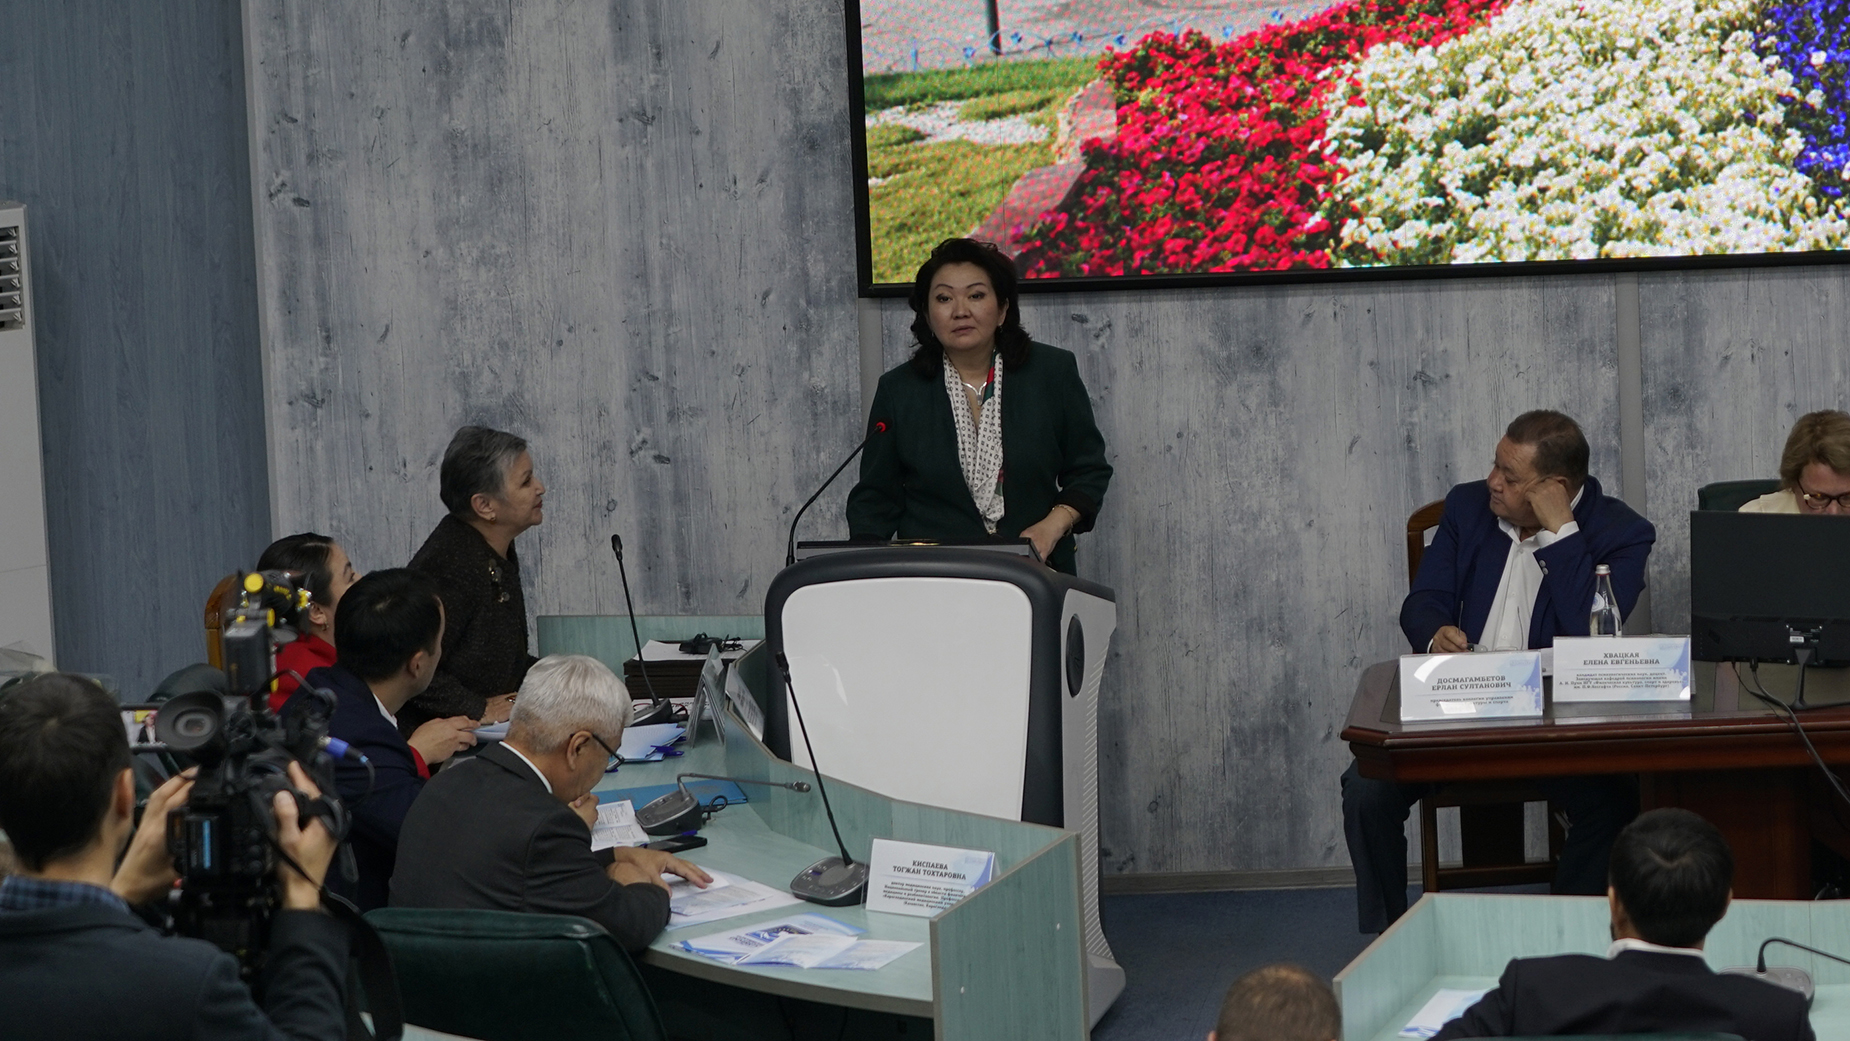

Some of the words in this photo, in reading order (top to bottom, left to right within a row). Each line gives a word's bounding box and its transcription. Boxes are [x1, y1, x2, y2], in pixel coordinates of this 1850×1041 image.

[1603, 652, 1640, 660] ХВАЦКАЯ
[1436, 675, 1506, 685] ДОСМАГАМБЕТОВ
[1459, 682, 1512, 690] СУЛТАНОВИЧ
[912, 860, 949, 871] КИСПАЕВА
[893, 865, 921, 875] ТОГЖАН
[922, 869, 967, 880] ТОХТАРОВНА
